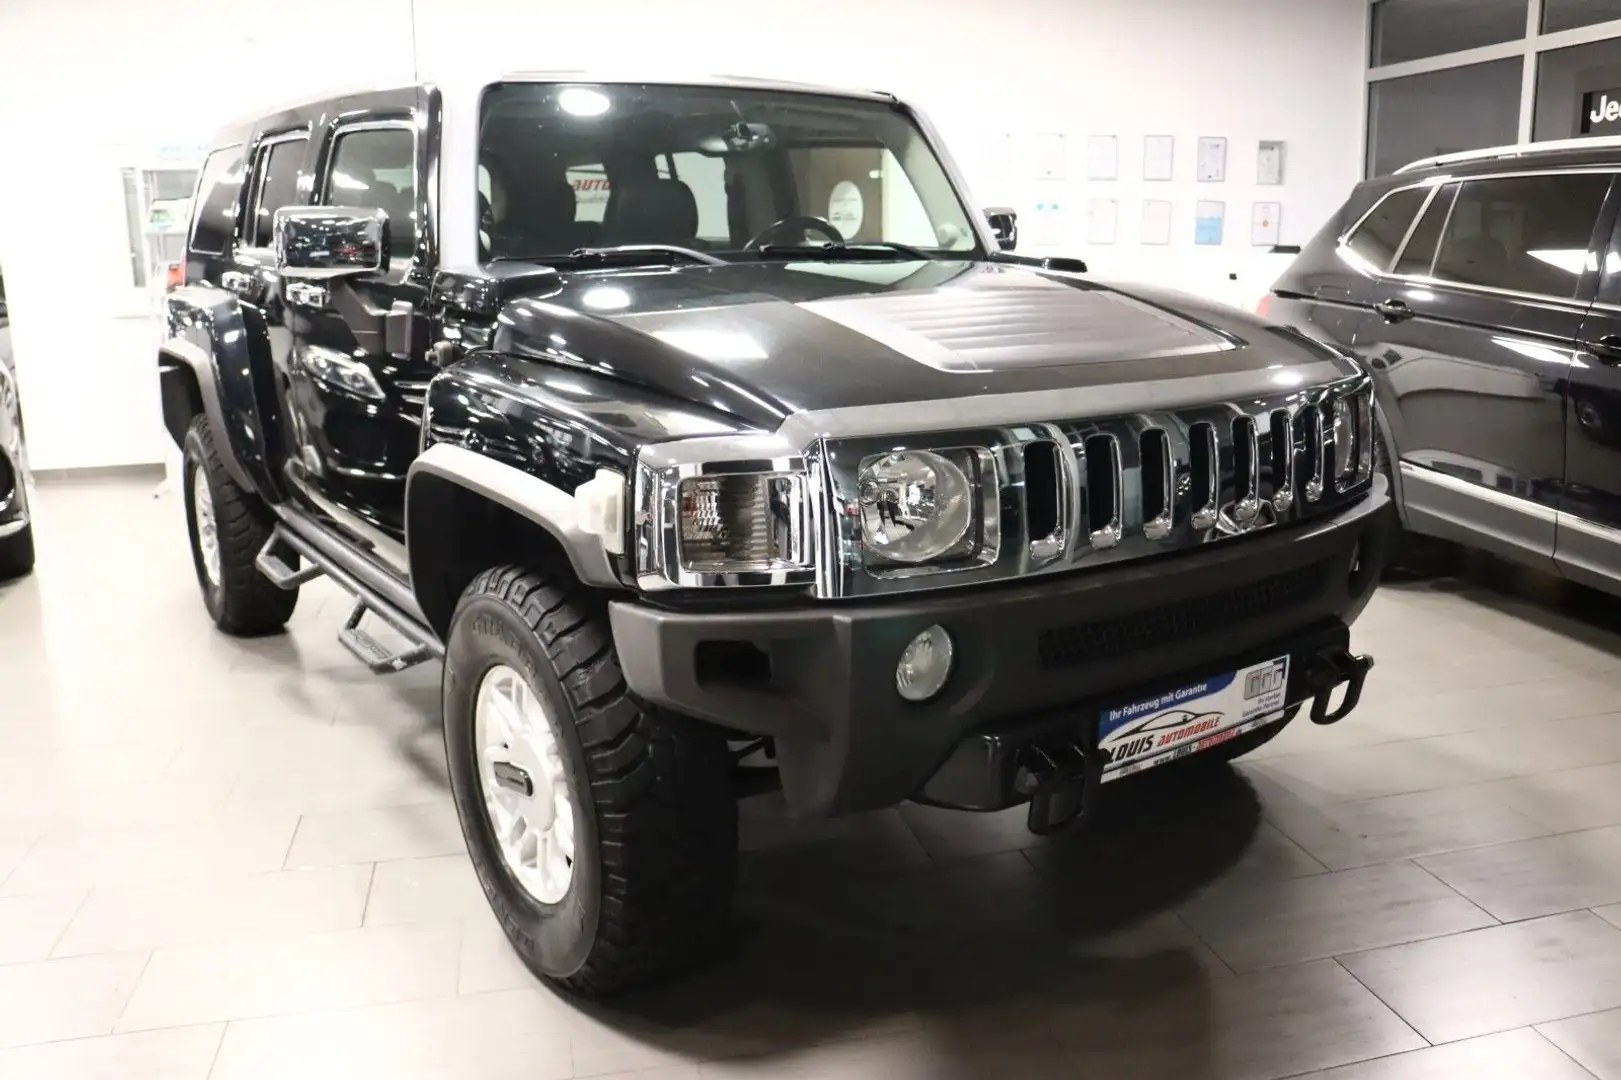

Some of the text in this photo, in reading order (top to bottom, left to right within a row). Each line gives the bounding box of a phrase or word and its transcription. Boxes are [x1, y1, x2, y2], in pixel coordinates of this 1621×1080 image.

[1590, 95, 1621, 123] Je
[1109, 683, 1207, 721] Ihr Fahrzeug mit Garantie
